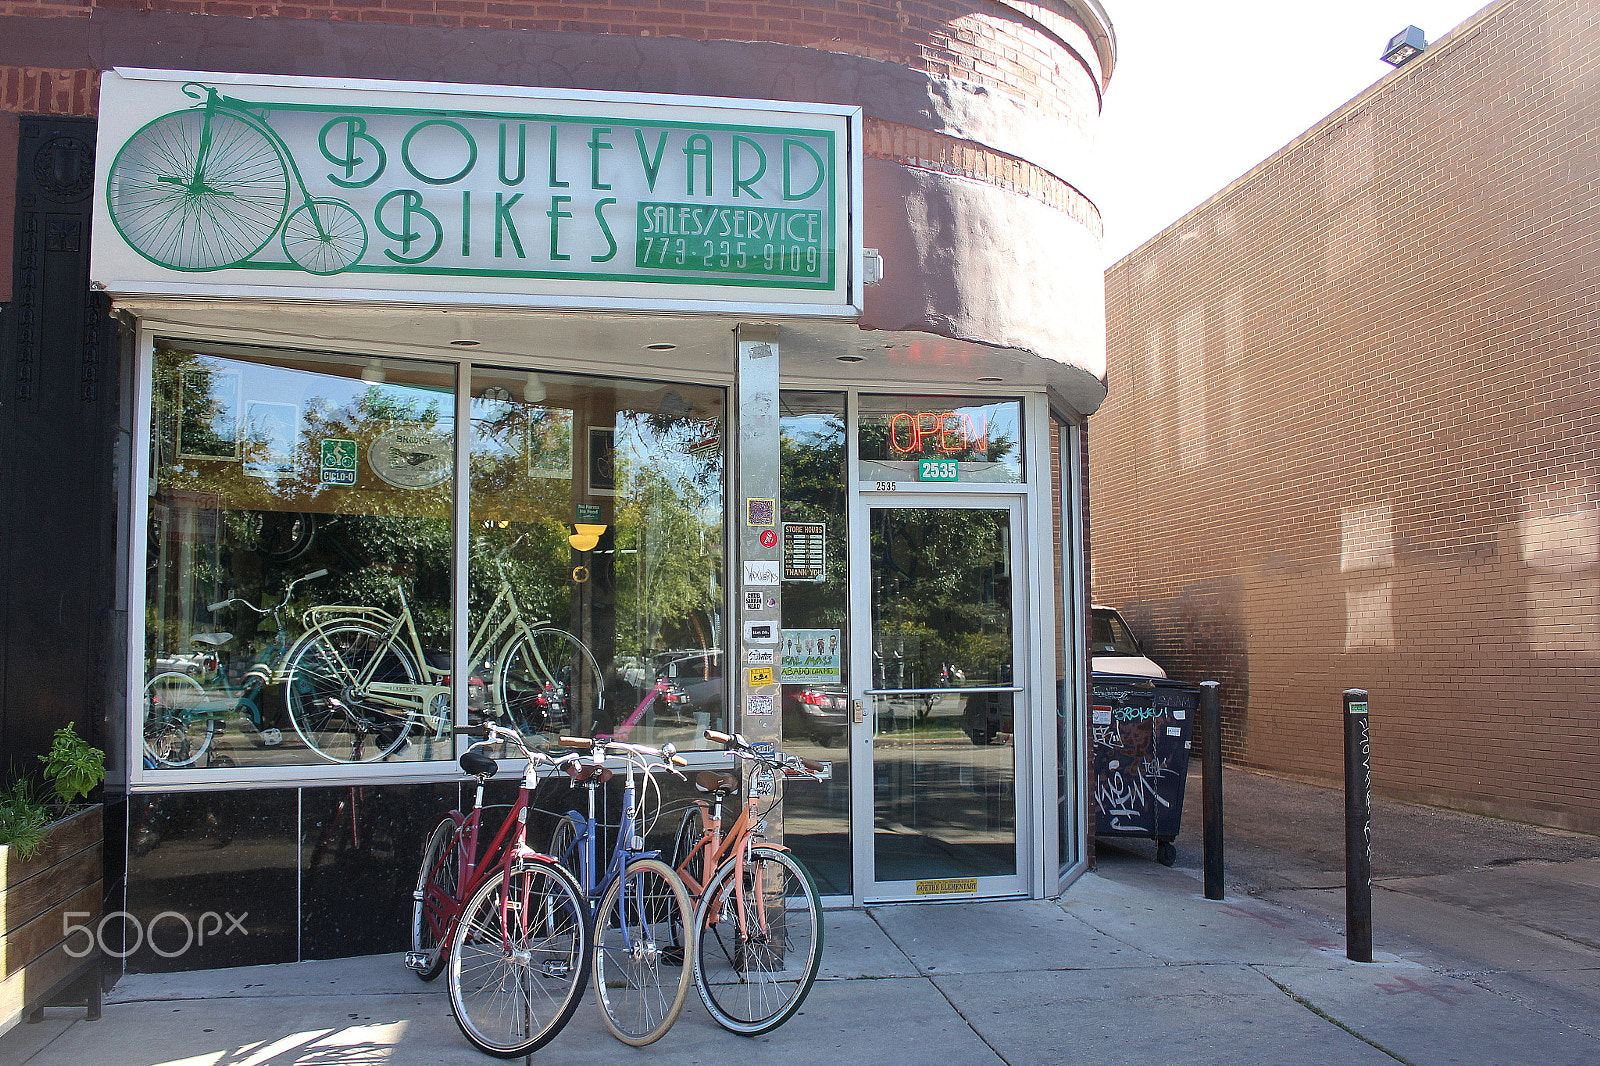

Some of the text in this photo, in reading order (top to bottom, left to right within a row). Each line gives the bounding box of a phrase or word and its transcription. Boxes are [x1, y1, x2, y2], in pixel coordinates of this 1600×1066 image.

[318, 115, 826, 202] BOULEVARD
[373, 189, 618, 265] BIKES
[642, 205, 819, 244] SALES/SERVICE
[891, 412, 987, 452] OPEN
[921, 463, 957, 478] 2535
[876, 481, 897, 491] 2535
[785, 525, 823, 534] STORE HOURS
[785, 568, 808, 577] THANK
[809, 568, 823, 577] YOU
[941, 882, 977, 891] ELEMENTARY
